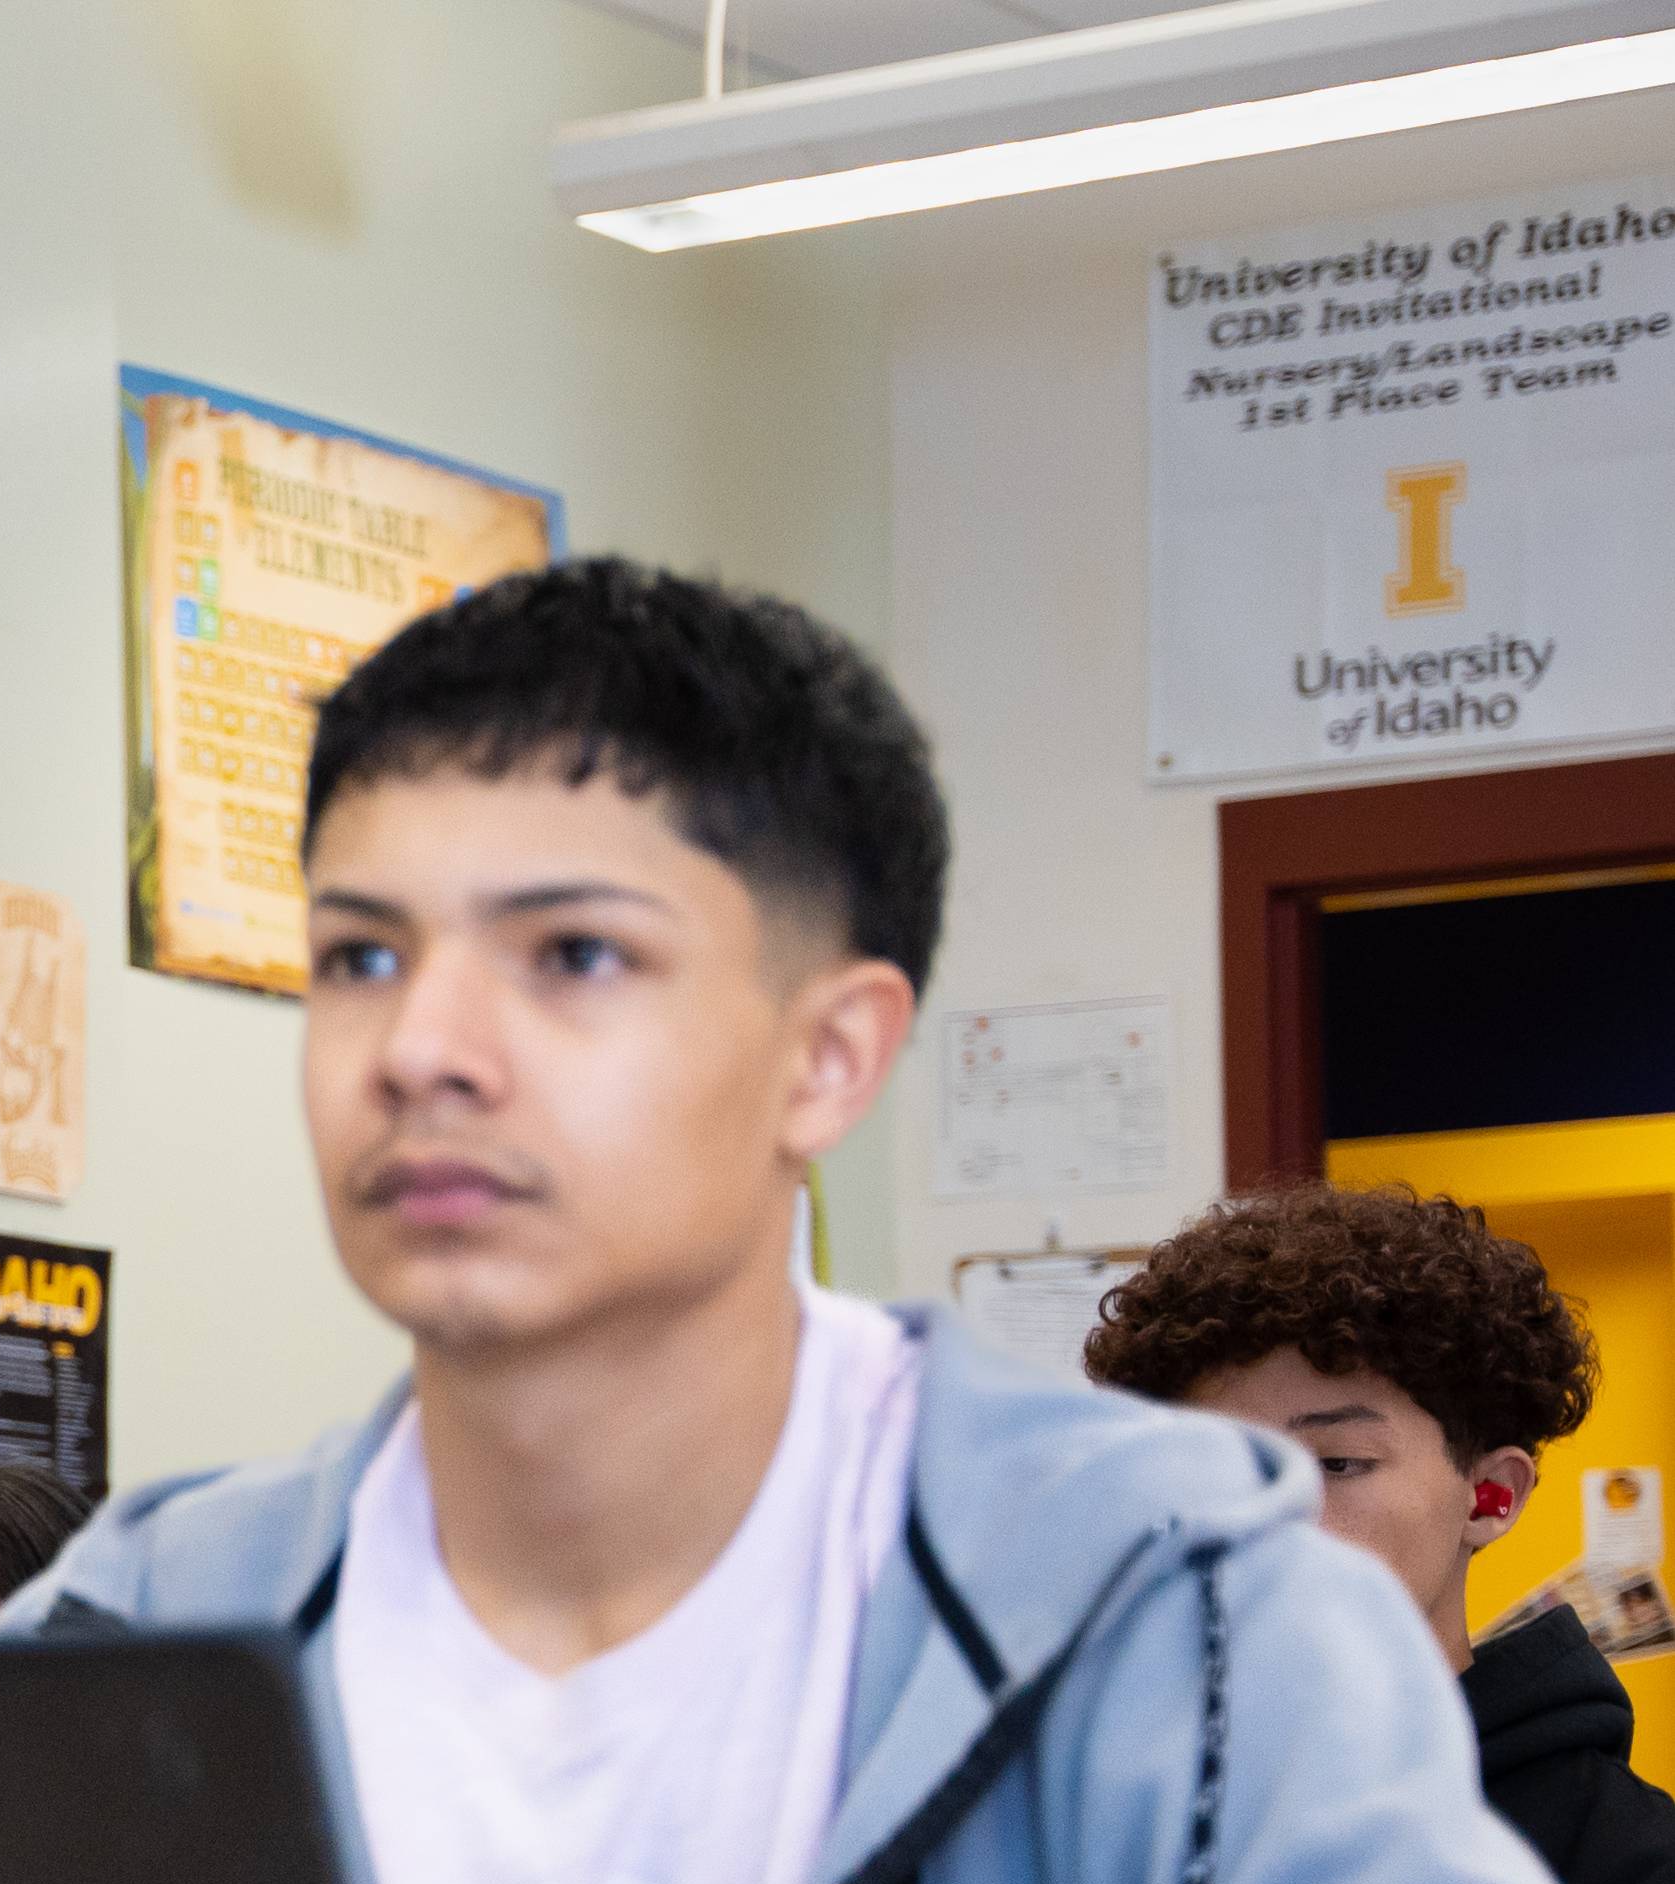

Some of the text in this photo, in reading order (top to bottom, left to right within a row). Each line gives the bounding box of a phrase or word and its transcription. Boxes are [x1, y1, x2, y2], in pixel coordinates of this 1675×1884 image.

[1164, 203, 1675, 309] University of Idaho
[1207, 259, 1602, 350] CDE Invitational
[1186, 309, 1672, 401] Nursery/Landscape
[1239, 357, 1619, 431] 1st Place Team
[255, 520, 406, 605] ELEMENTS
[348, 496, 429, 560] TABLE
[1294, 634, 1554, 699] University
[1327, 690, 1518, 752] of Idaho
